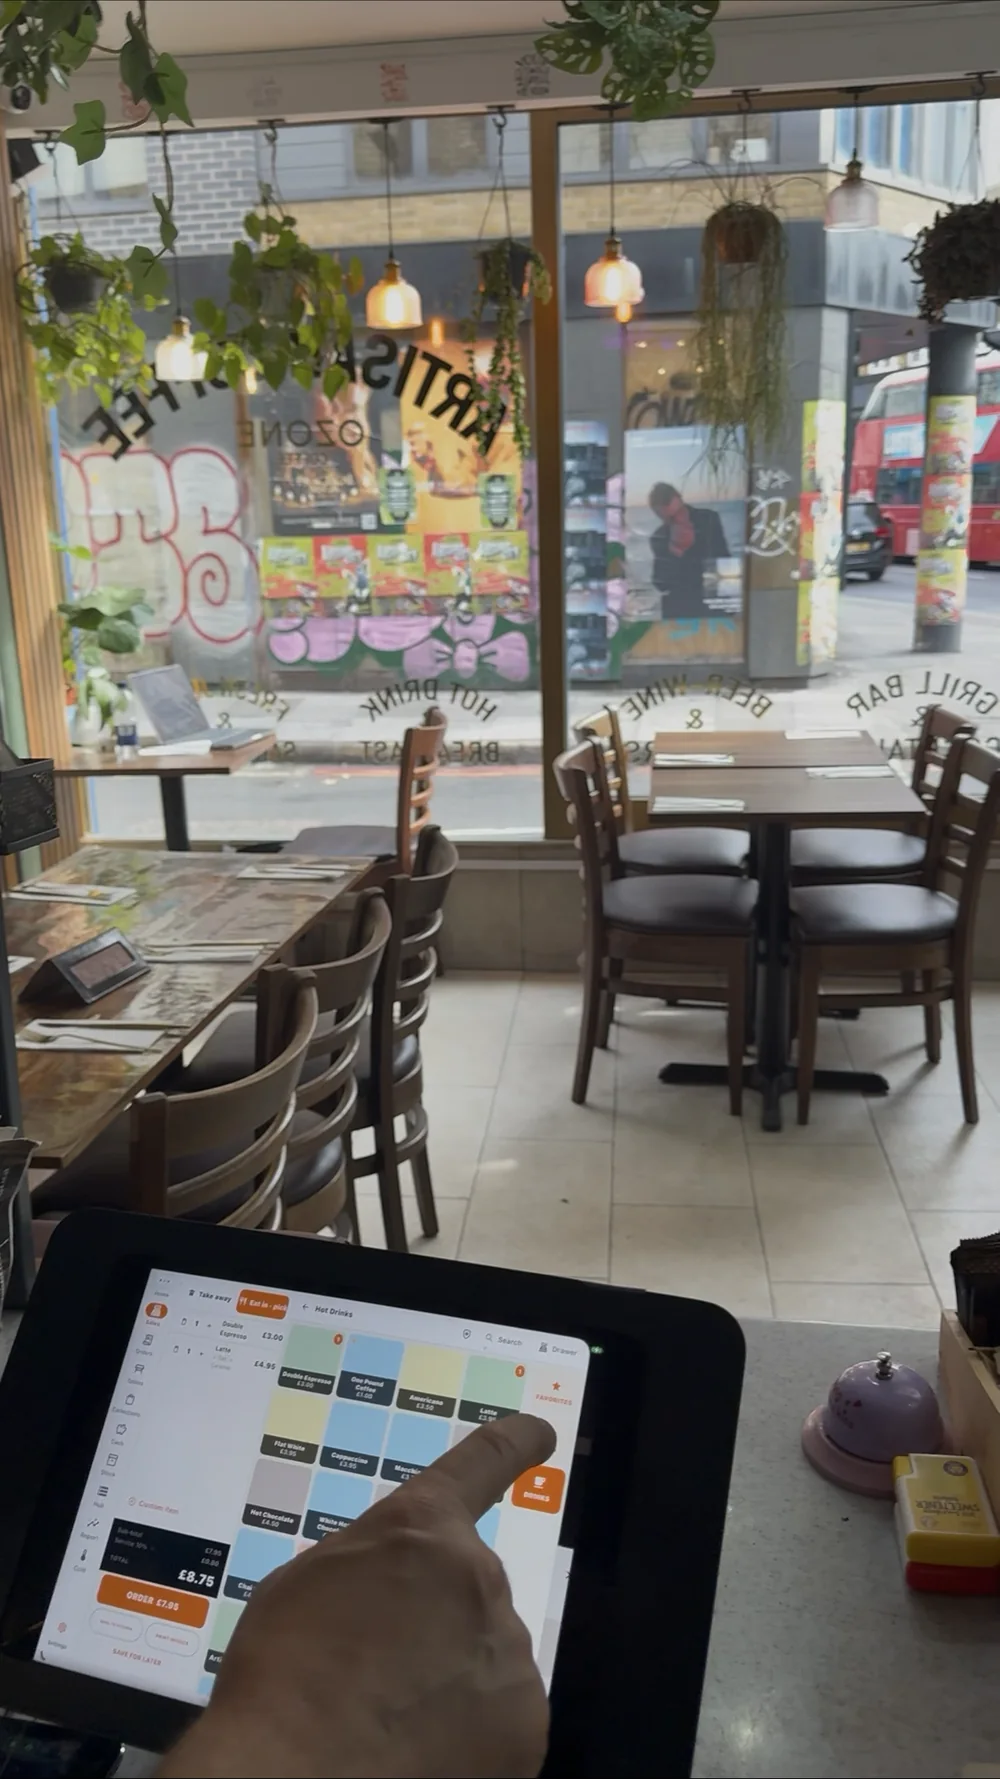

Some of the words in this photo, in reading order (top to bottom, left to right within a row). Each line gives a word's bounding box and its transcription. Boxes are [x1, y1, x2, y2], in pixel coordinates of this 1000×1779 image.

[198, 1290, 214, 1300] Take
[214, 1294, 233, 1304] away
[249, 1299, 261, 1308] Eat
[314, 1305, 329, 1315] Hot
[329, 1308, 353, 1318] Drinks
[221, 1320, 244, 1330] Double
[219, 1329, 248, 1341] Espresso
[261, 1331, 284, 1342] £3.00
[497, 1336, 523, 1347] Search
[215, 1345, 232, 1354] Latte
[552, 1345, 578, 1357] Drawer
[253, 1359, 277, 1371] £4.95
[282, 1371, 304, 1382] Double
[304, 1375, 333, 1386] Espresso
[350, 1376, 364, 1385] One
[363, 1379, 385, 1389] Pound
[355, 1384, 377, 1394] Coffee
[408, 1394, 444, 1407] Americano
[535, 1393, 573, 1407] FAVORITES
[415, 1402, 435, 1412] £3.50
[479, 1407, 498, 1417] Latte
[273, 1440, 288, 1449] Flat
[287, 1443, 306, 1453] White
[331, 1451, 369, 1466] Cappuccino
[523, 1491, 551, 1503] DRINKS
[250, 1508, 263, 1517] Hot
[262, 1512, 295, 1524] Chocolate
[318, 1516, 338, 1526] White
[109, 1553, 129, 1565] TOTAL
[177, 1569, 216, 1588] £8.75
[238, 1582, 252, 1591] Chai
[126, 1590, 153, 1605] ORDER
[155, 1598, 180, 1612] £7.95
[112, 1647, 128, 1658] SAVE
[128, 1651, 142, 1662] FOR
[142, 1655, 162, 1667] LATER
